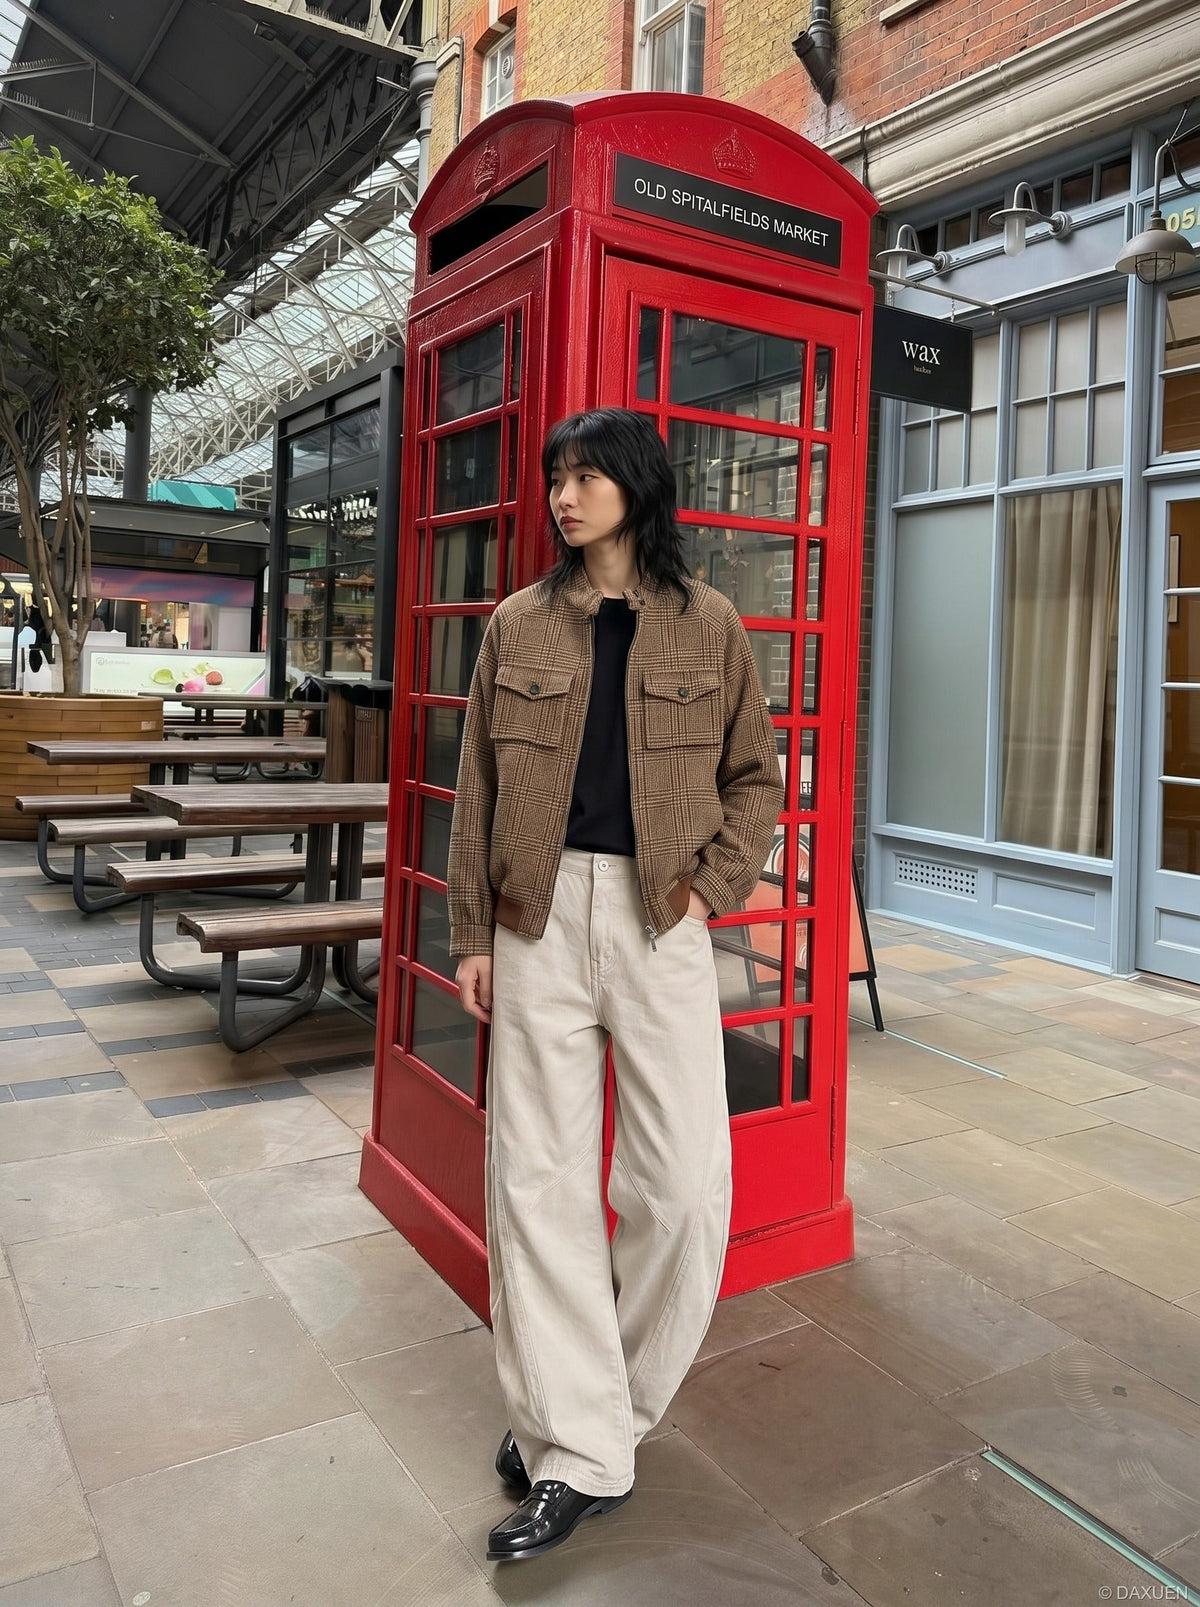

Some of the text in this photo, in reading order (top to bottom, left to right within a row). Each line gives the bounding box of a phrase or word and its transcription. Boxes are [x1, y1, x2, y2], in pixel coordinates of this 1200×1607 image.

[634, 178, 829, 247] OLD SPITALFIELDS MARKET
[1166, 207, 1200, 233] 05
[902, 340, 941, 365] wax
